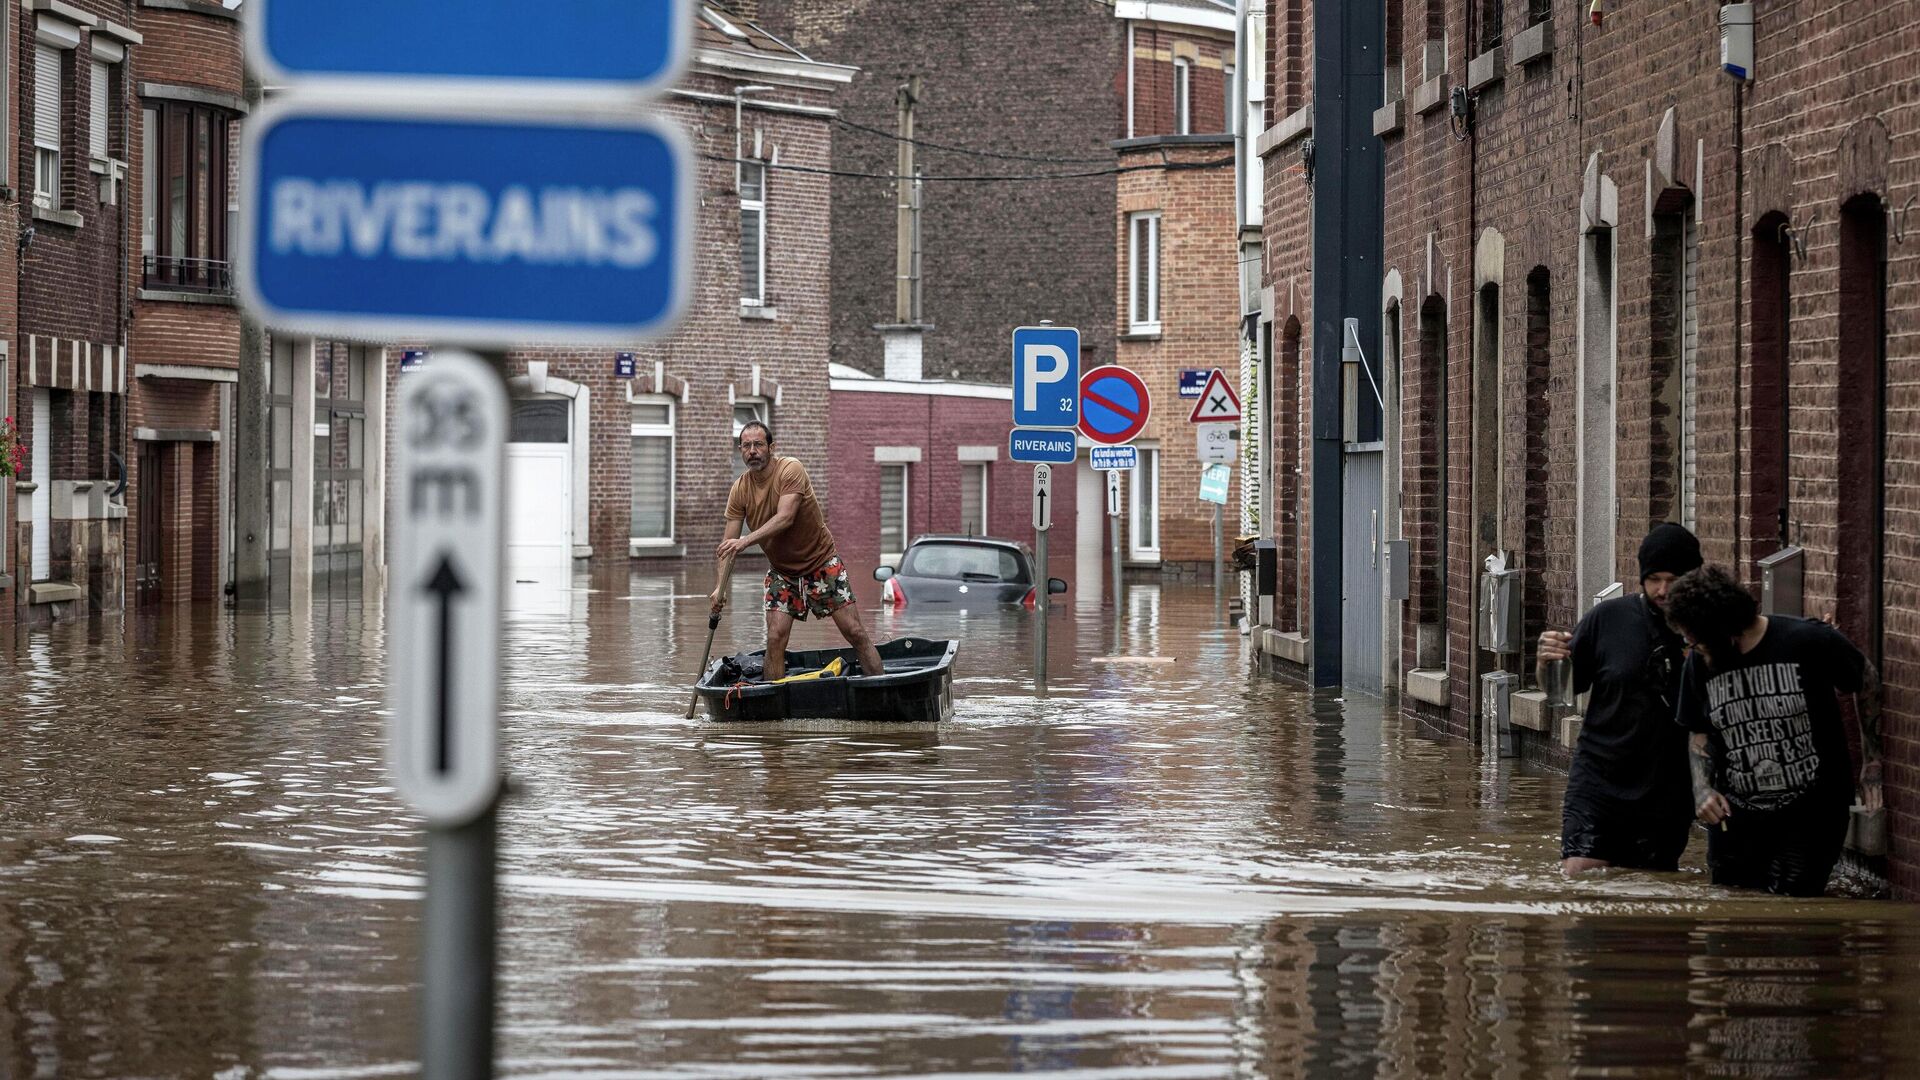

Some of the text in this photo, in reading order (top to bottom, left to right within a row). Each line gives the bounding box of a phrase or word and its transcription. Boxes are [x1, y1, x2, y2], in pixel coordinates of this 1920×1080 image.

[270, 177, 660, 269] RIVERAINS
[1024, 344, 1069, 411] P
[1059, 398, 1073, 412] 32
[1014, 439, 1072, 453] RIVERAINS
[409, 464, 483, 521] m
[1706, 663, 1804, 710] WHEN YOU DIE
[1725, 698, 1755, 726] ONLY
[1755, 693, 1808, 719] KINGDOM
[1747, 720, 1772, 744] SEE
[1771, 718, 1785, 740] IS
[1784, 713, 1811, 737] TWO
[1745, 742, 1780, 767] WIDE
[1781, 739, 1795, 763] &
[1795, 732, 1817, 758] SIX
